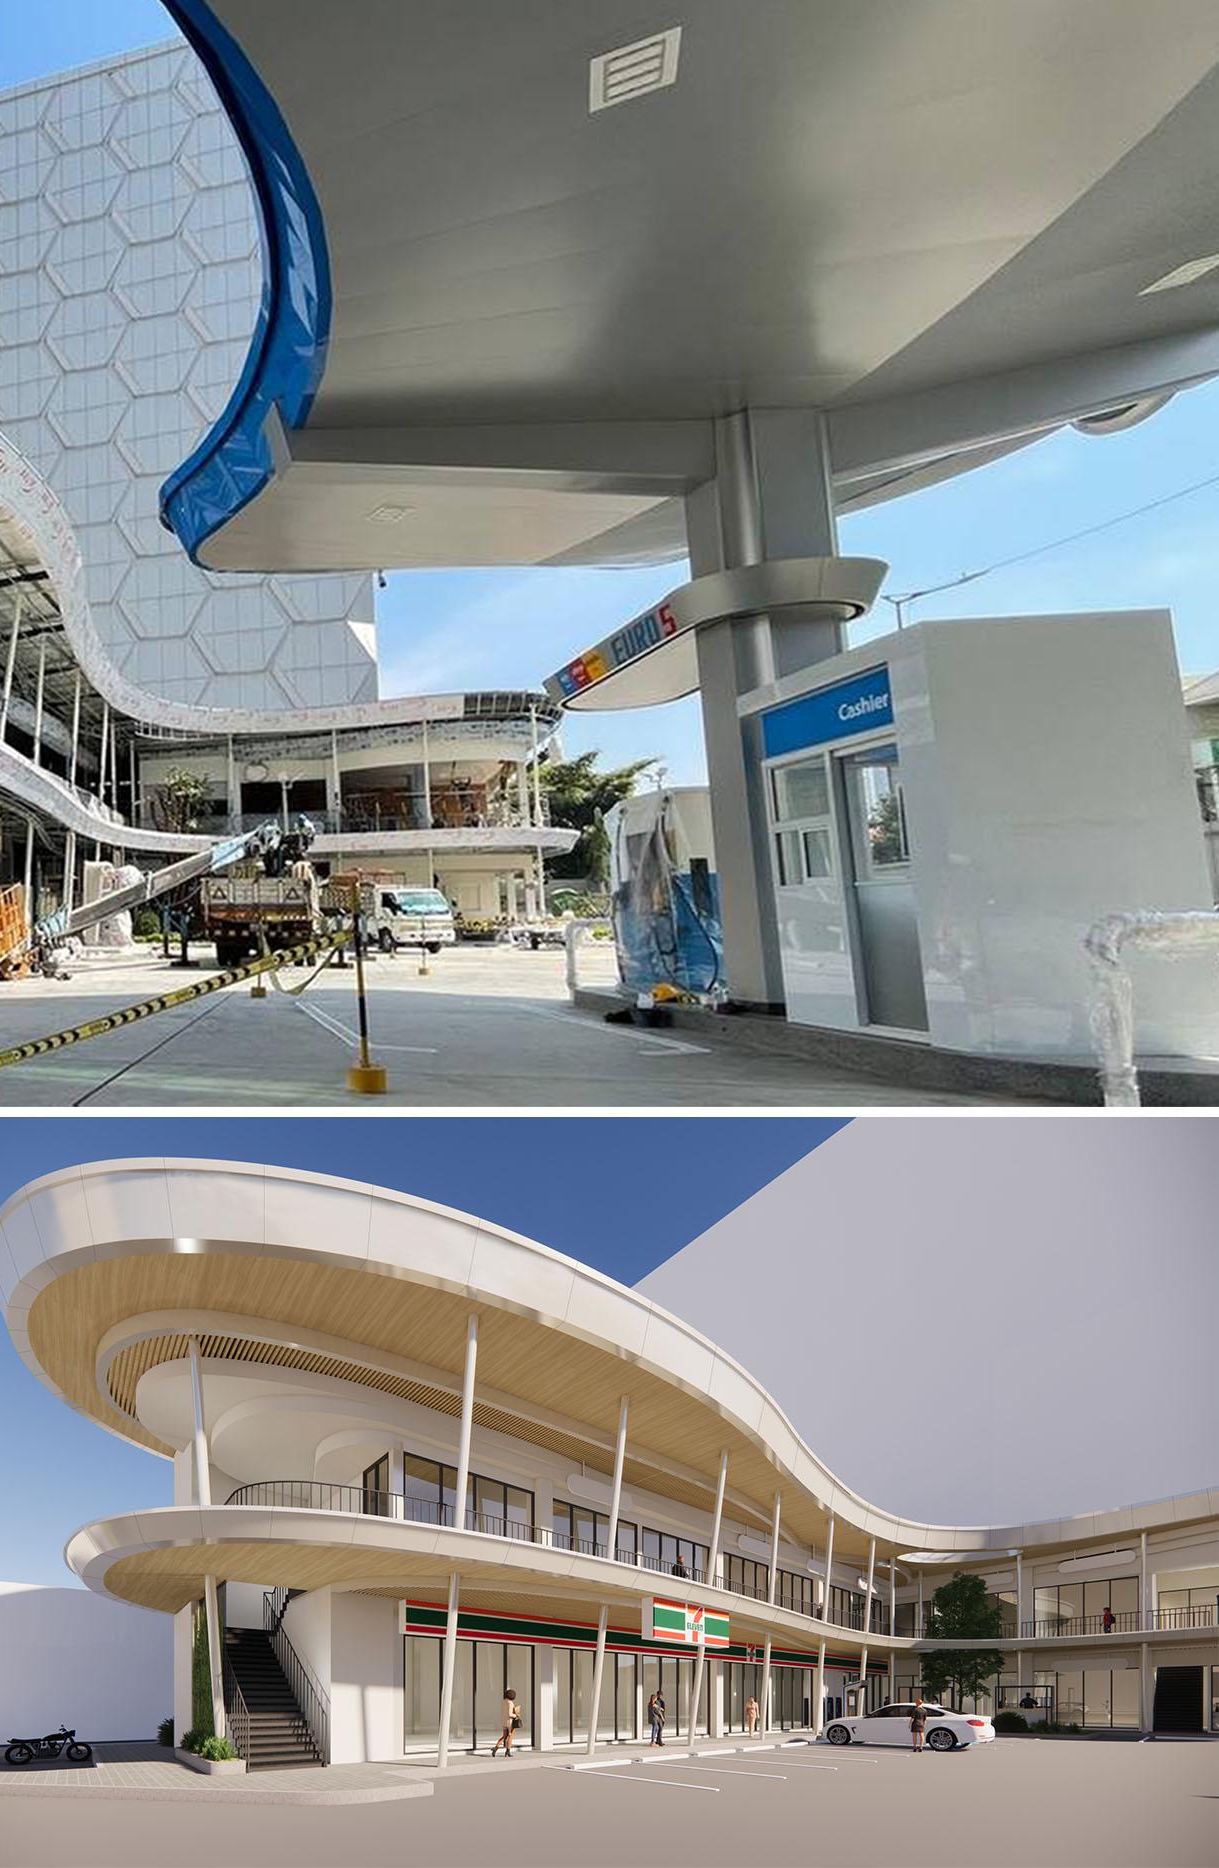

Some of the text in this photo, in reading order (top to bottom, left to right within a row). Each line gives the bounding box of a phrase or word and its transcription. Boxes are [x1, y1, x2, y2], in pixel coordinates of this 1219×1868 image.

[610, 603, 677, 663] EURO 5
[838, 693, 889, 721] Cashier
